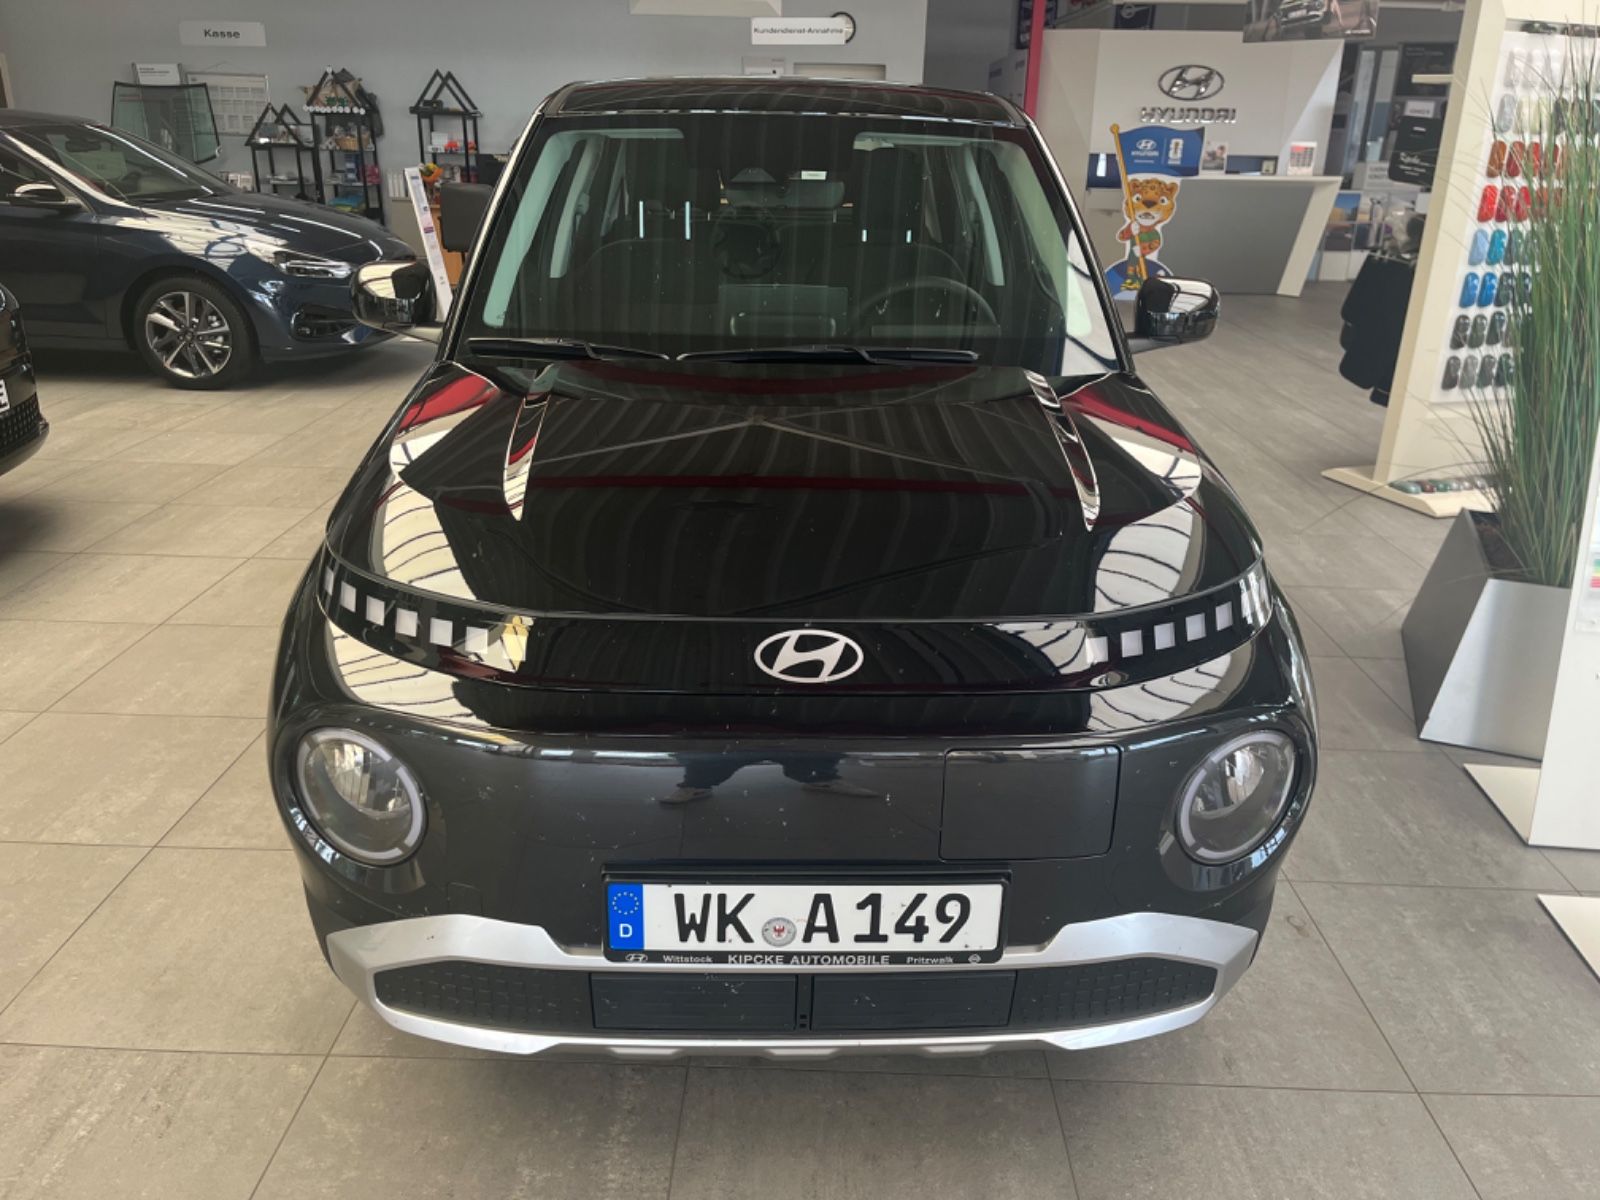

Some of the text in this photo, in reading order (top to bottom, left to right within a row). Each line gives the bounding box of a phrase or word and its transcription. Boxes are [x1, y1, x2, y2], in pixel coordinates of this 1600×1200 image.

[203, 28, 241, 39] Kasse
[753, 26, 844, 35] Kundendienst-Annahme
[1141, 106, 1237, 123] HYUNDAI
[673, 893, 756, 944] WK
[619, 923, 633, 939] D
[662, 954, 954, 966] Wittstock KIPCKE AUTOMOBILE Pritzwalk
